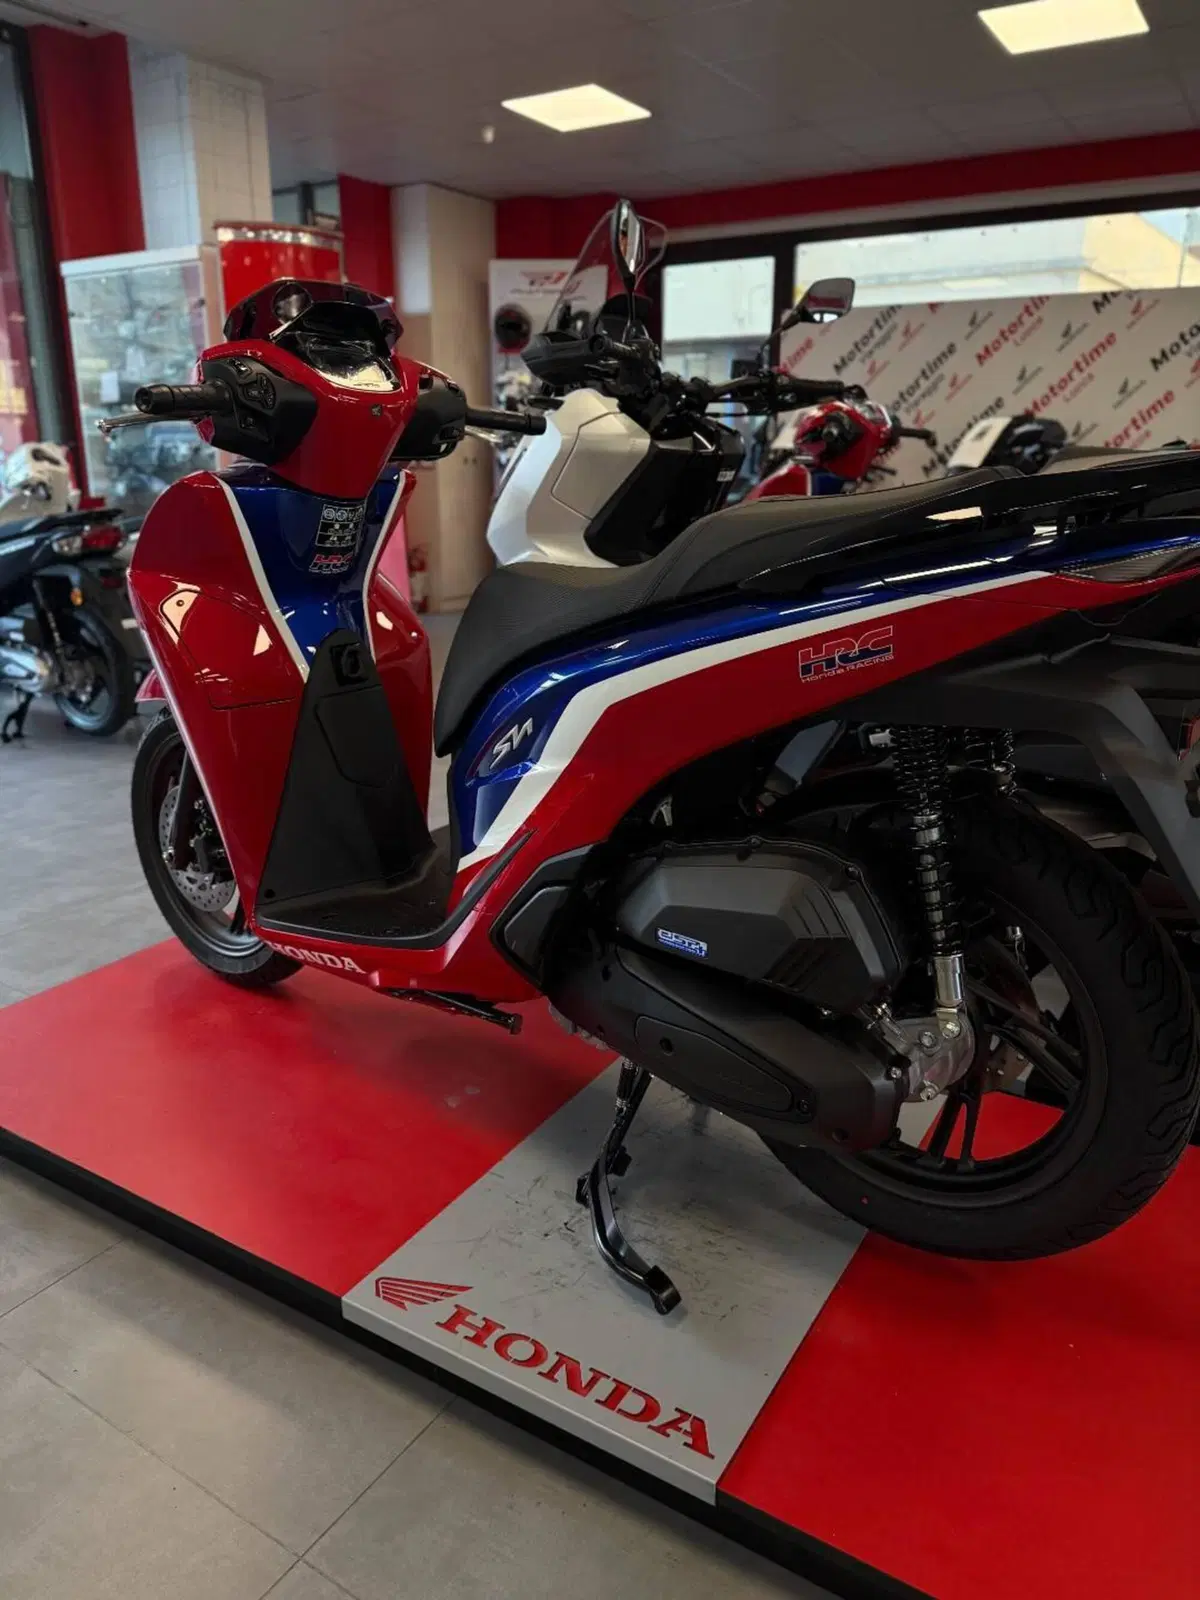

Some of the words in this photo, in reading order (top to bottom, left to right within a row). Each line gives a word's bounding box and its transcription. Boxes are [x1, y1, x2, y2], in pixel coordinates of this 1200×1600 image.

[834, 305, 902, 375] Motortim
[975, 296, 1050, 367] Motortim
[1150, 322, 1200, 371] Moto
[889, 341, 957, 412] otortime
[1104, 389, 1176, 449] tortime
[798, 624, 894, 679] HRC
[846, 655, 895, 672] RACING
[263, 940, 366, 974] HONDA
[435, 1303, 715, 1460] HONDA
